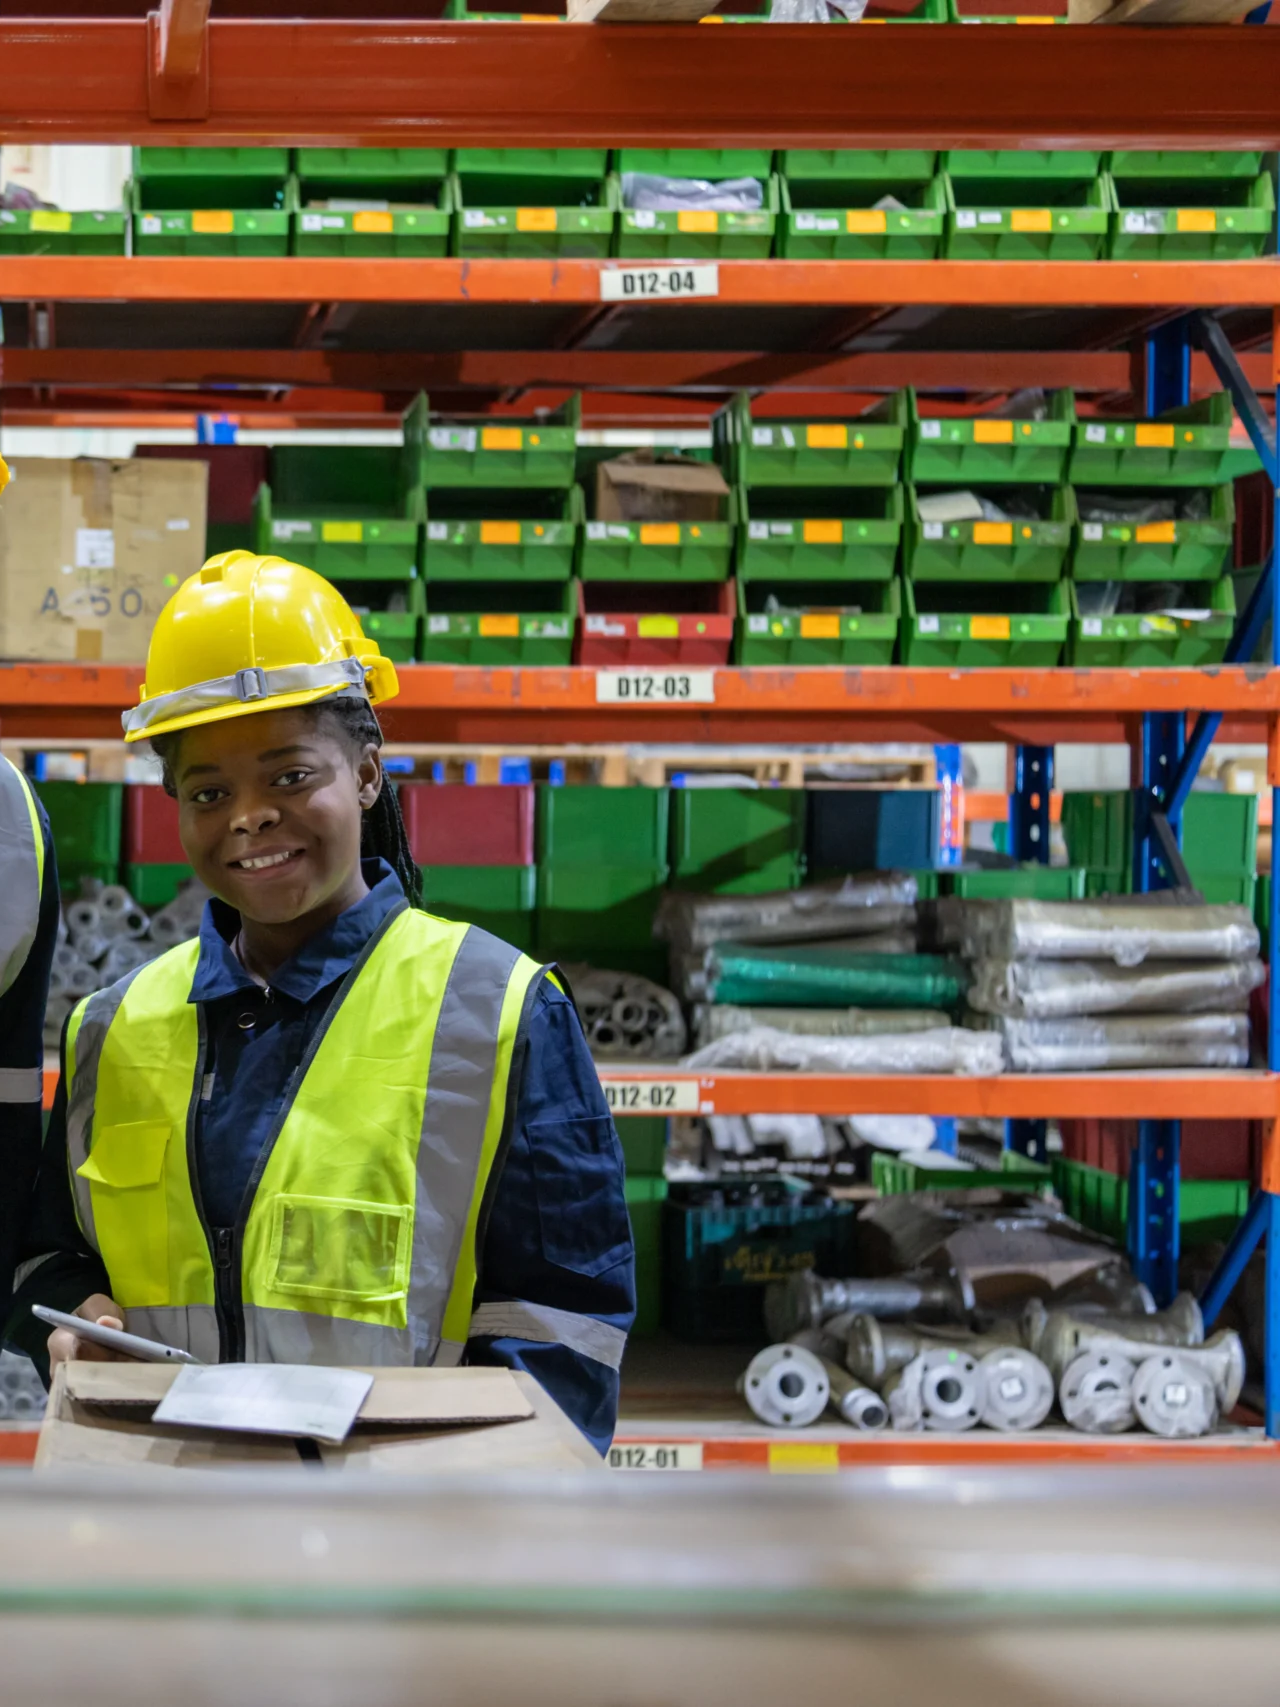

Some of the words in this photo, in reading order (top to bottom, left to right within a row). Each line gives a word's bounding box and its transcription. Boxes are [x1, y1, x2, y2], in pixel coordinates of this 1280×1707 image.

[622, 271, 696, 295] D12-04
[617, 676, 691, 699] D12-03
[609, 1447, 680, 1469] D12-01
